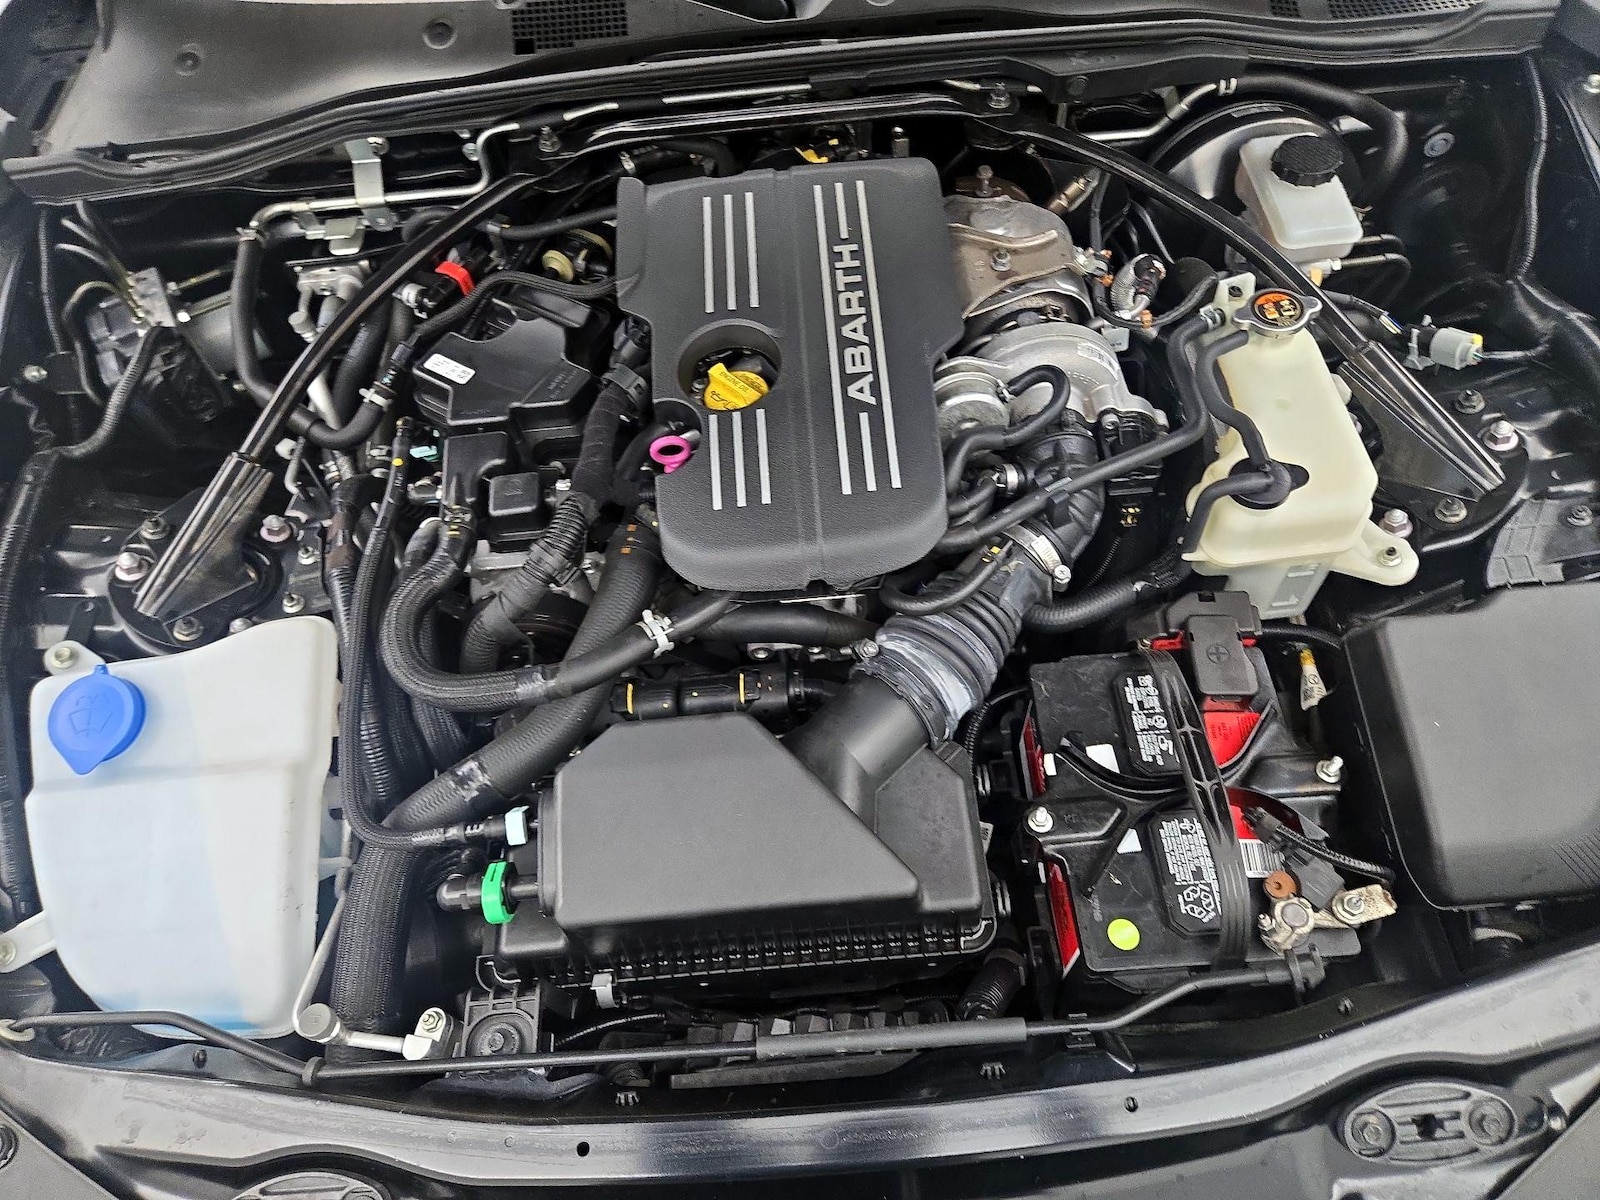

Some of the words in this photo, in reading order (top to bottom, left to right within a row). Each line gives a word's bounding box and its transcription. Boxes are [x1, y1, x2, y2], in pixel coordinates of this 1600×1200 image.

[832, 243, 877, 405] ABARTH
[719, 371, 740, 387] ENGINE
[738, 383, 750, 394] OIL
